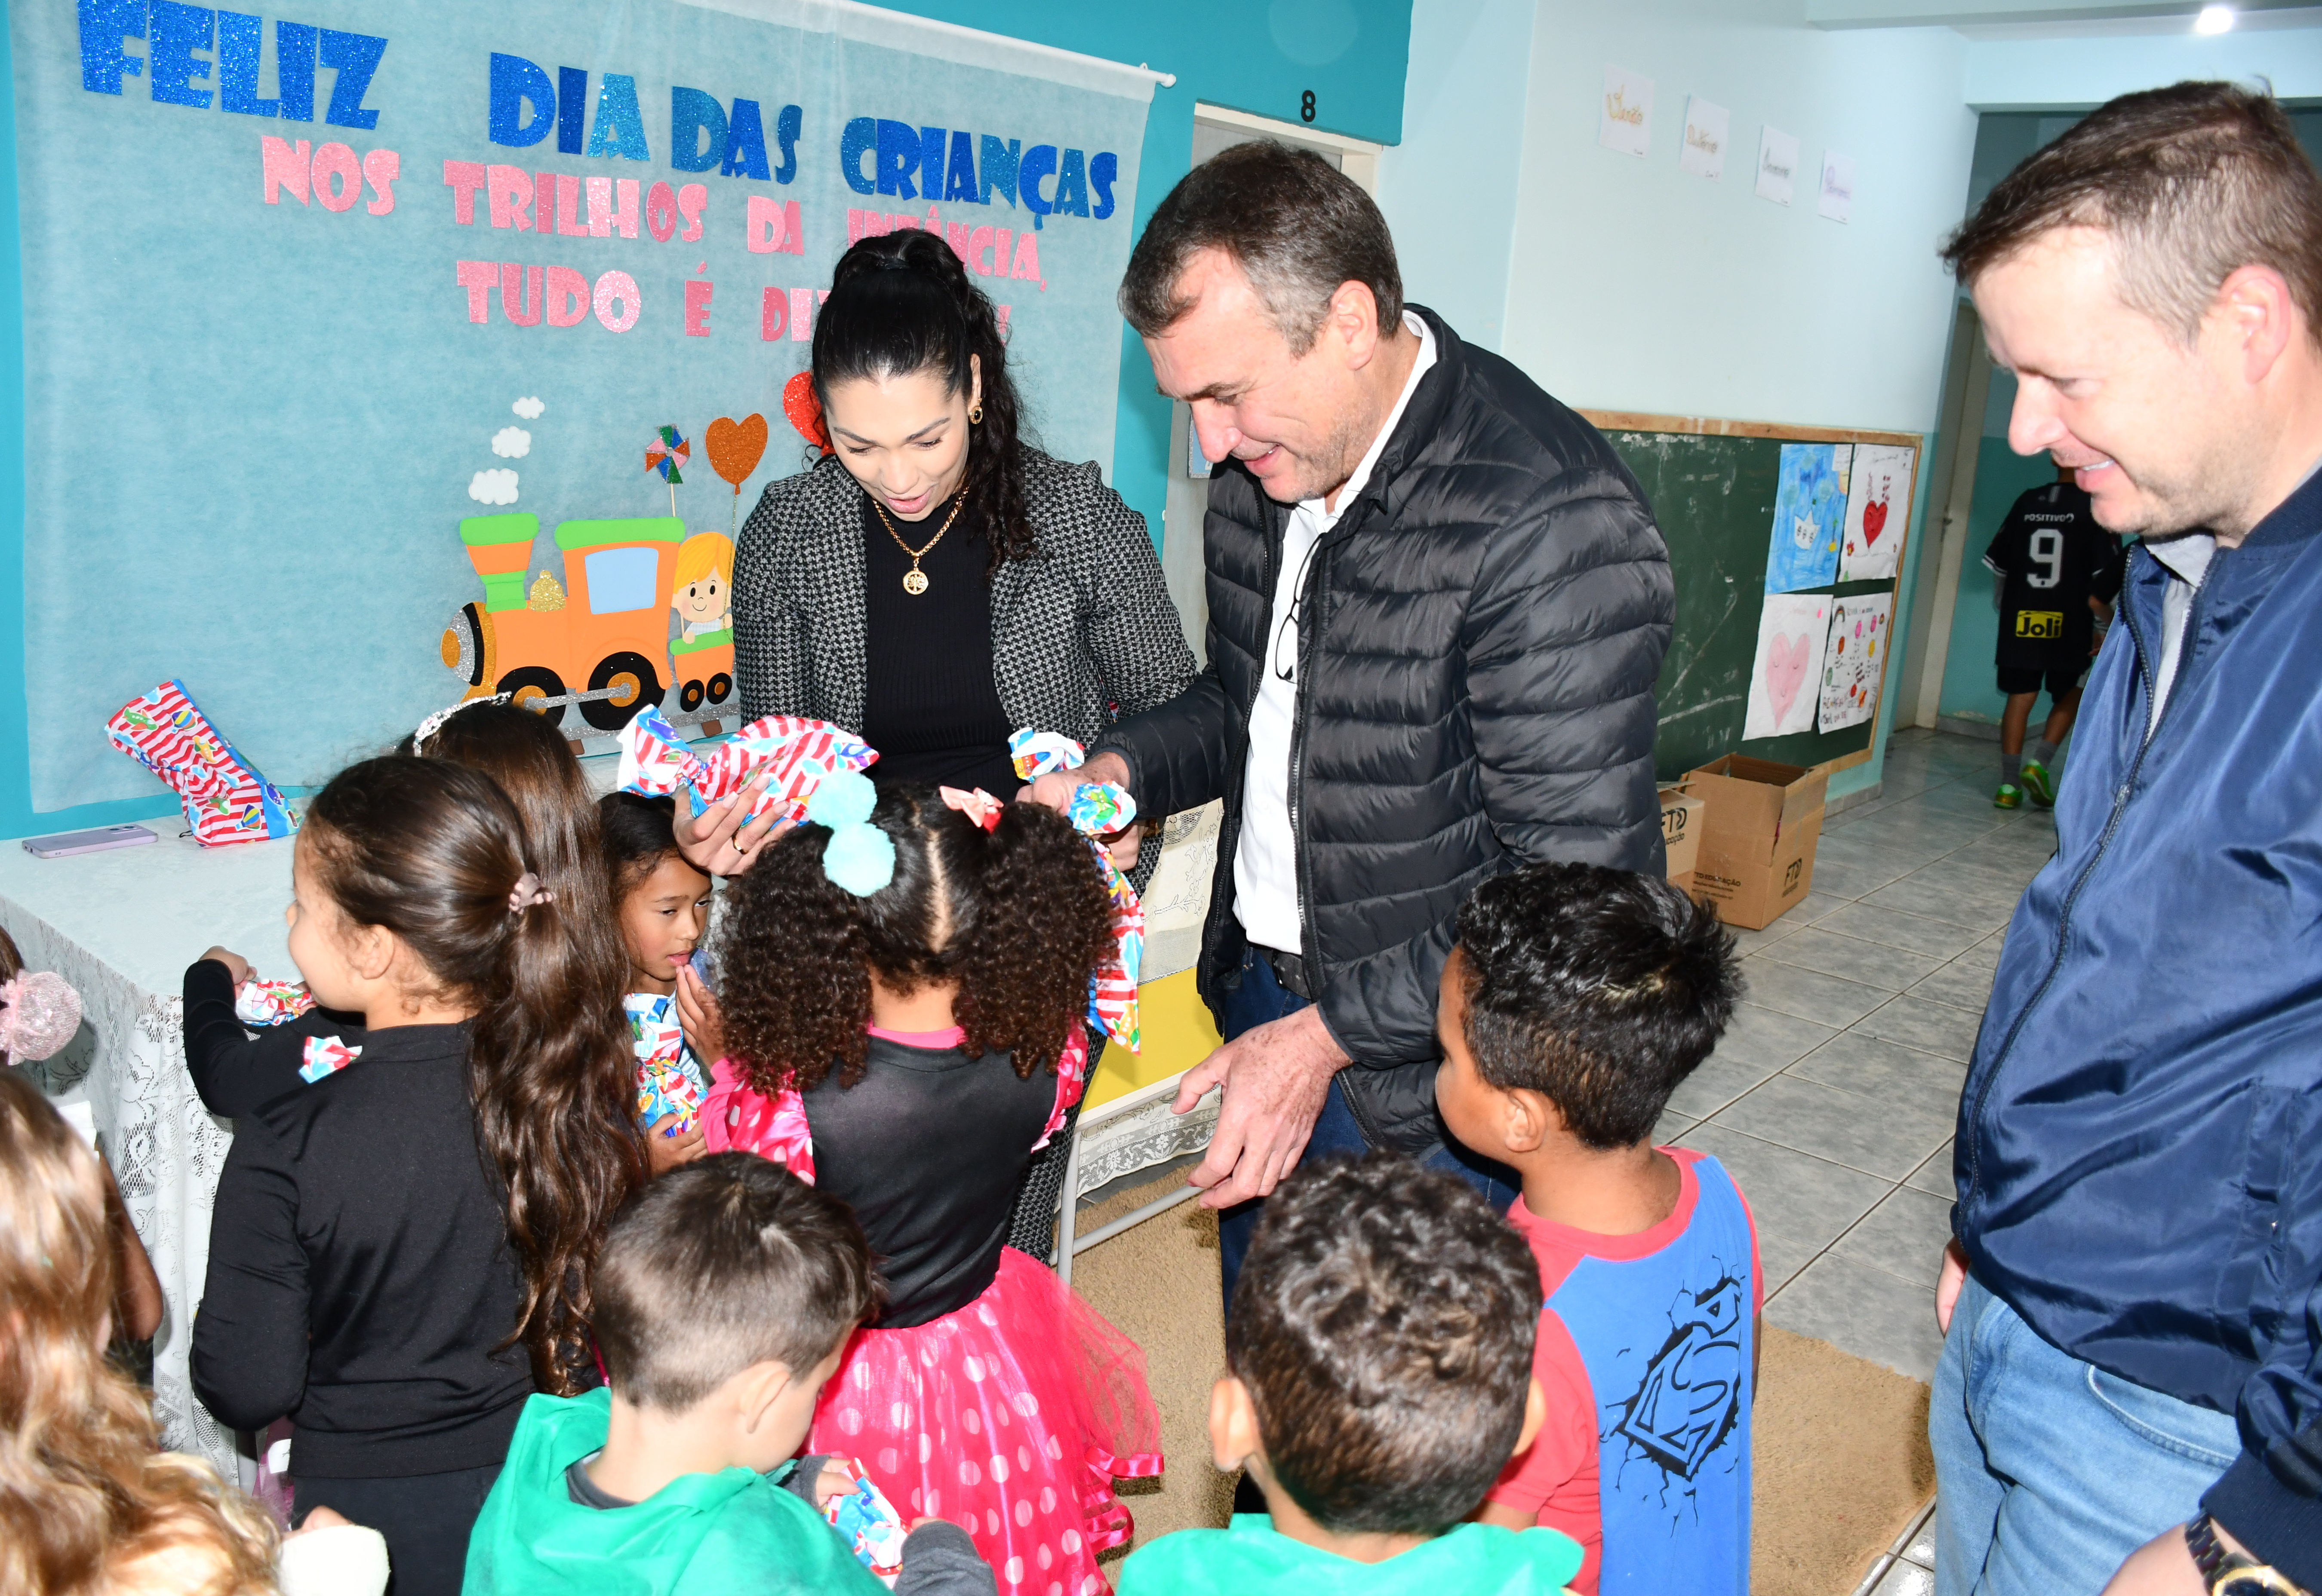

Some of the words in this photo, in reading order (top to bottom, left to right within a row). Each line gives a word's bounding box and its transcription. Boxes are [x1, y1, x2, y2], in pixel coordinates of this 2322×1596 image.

[78, 0, 388, 130] FELIZ
[489, 52, 650, 161] DIA
[672, 86, 803, 185] DAS
[841, 117, 1117, 230] CRIANÇAS
[1301, 90, 1315, 122] 8
[261, 135, 400, 216] NOS
[444, 159, 707, 243] TRILHOS
[747, 196, 803, 256] DA
[457, 260, 641, 334] TUDO
[685, 261, 713, 337] É
[2024, 513, 2066, 522] POSITIVO
[2027, 528, 2064, 589] 9
[2017, 617, 2061, 636] Joli
